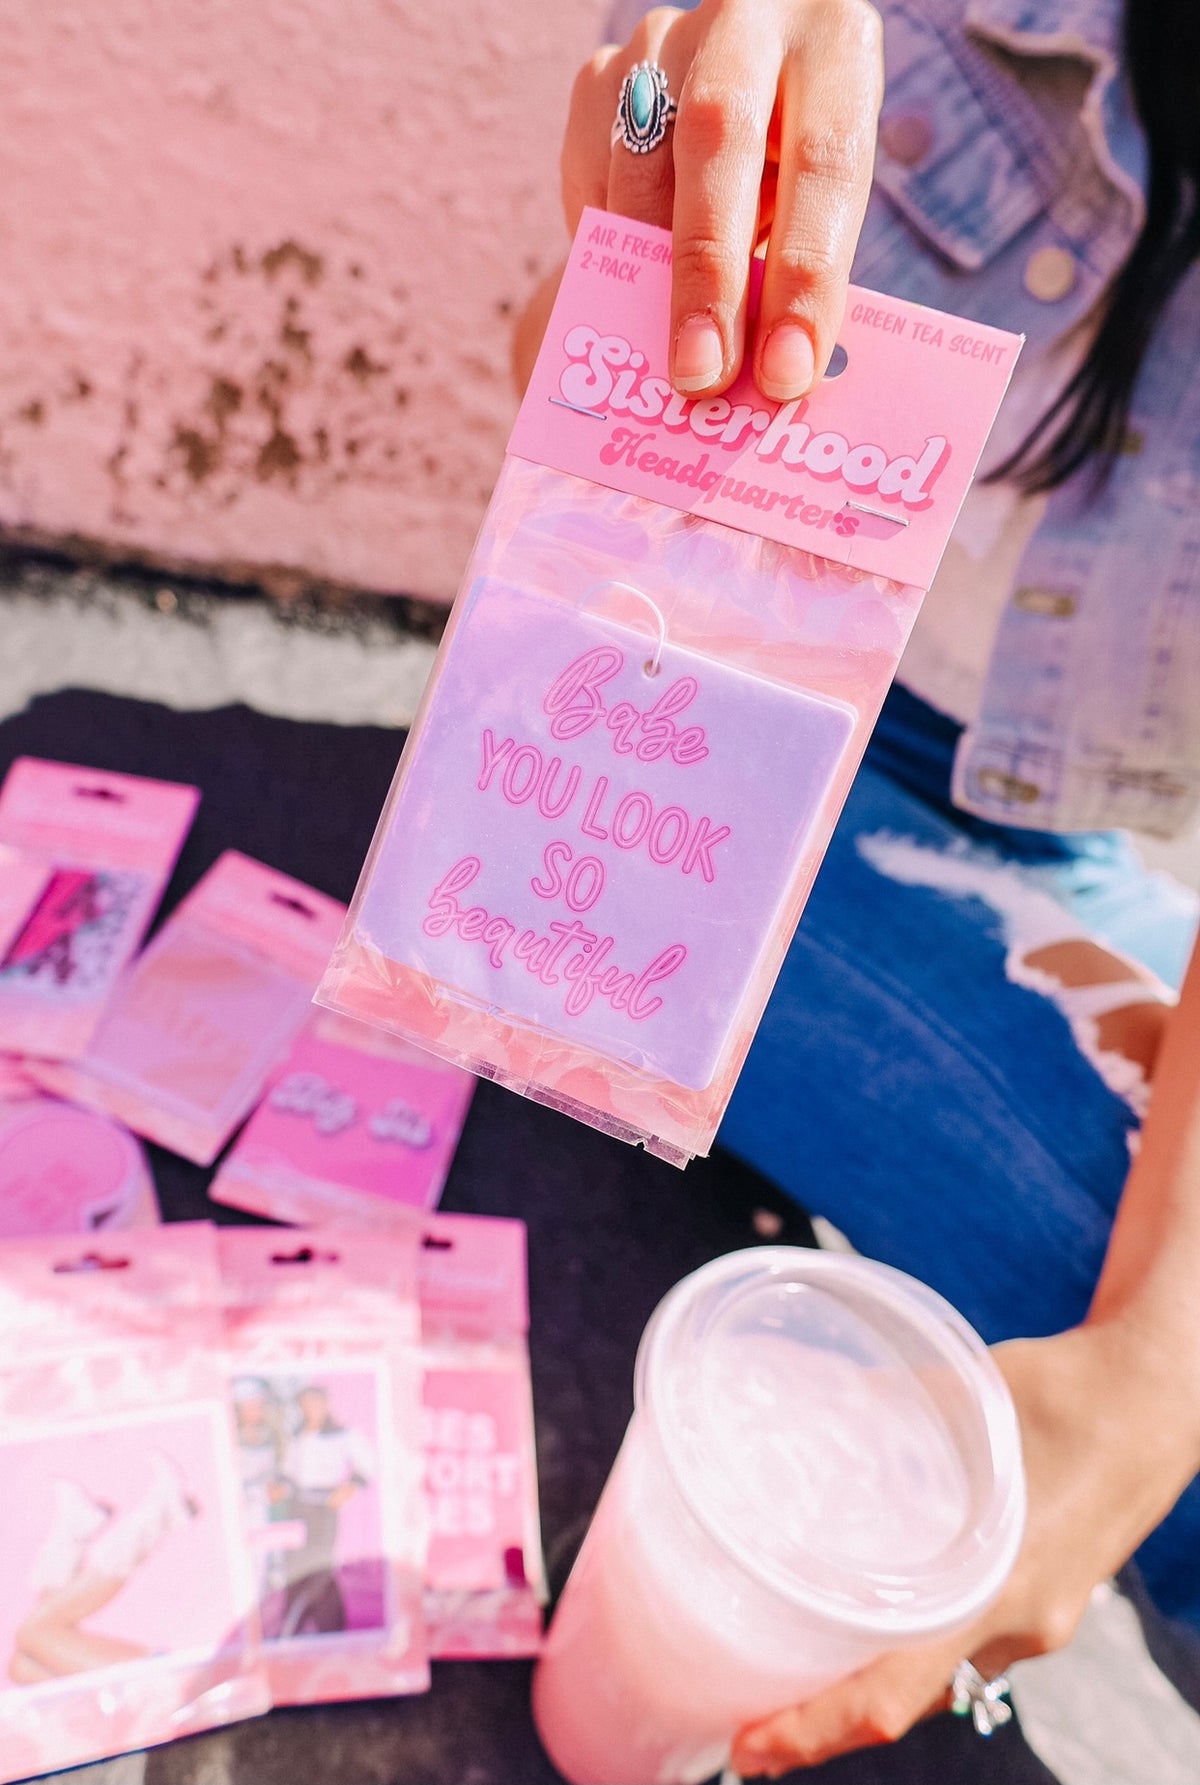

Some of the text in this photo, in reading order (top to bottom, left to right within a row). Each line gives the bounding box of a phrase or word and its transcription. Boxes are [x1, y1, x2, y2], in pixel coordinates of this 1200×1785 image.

[580, 250, 641, 284] 2-PACK
[588, 224, 617, 249] AIR
[851, 303, 1007, 365] GREEN TEA SCENT
[559, 325, 950, 511] Sisterhood
[600, 427, 859, 537] Headquarters
[543, 646, 709, 764] Babe
[477, 729, 731, 883] YOU LOOK
[531, 841, 605, 912] SO
[422, 856, 687, 1020] beautiful
